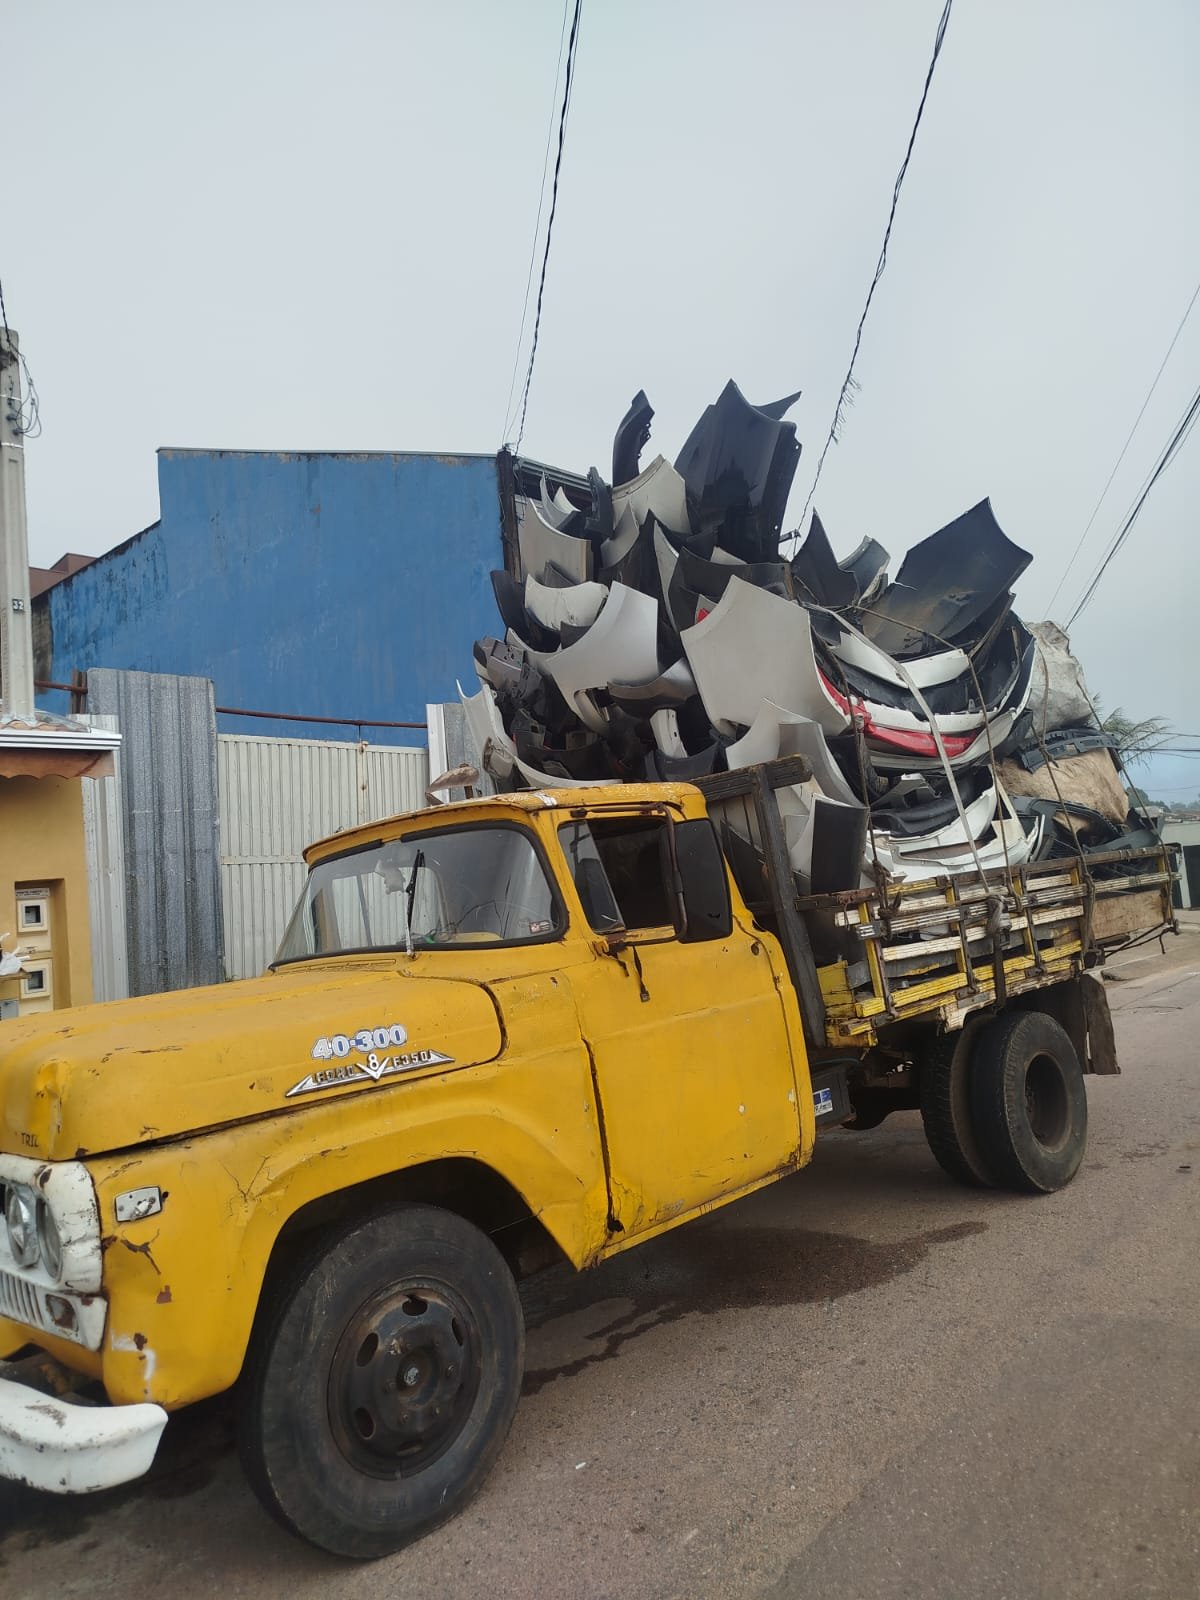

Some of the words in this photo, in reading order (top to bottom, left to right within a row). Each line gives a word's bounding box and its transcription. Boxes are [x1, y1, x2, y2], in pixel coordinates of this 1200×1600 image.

[311, 1023, 408, 1060] 40-300
[314, 1065, 355, 1083] FORD
[392, 1050, 429, 1067] F350
